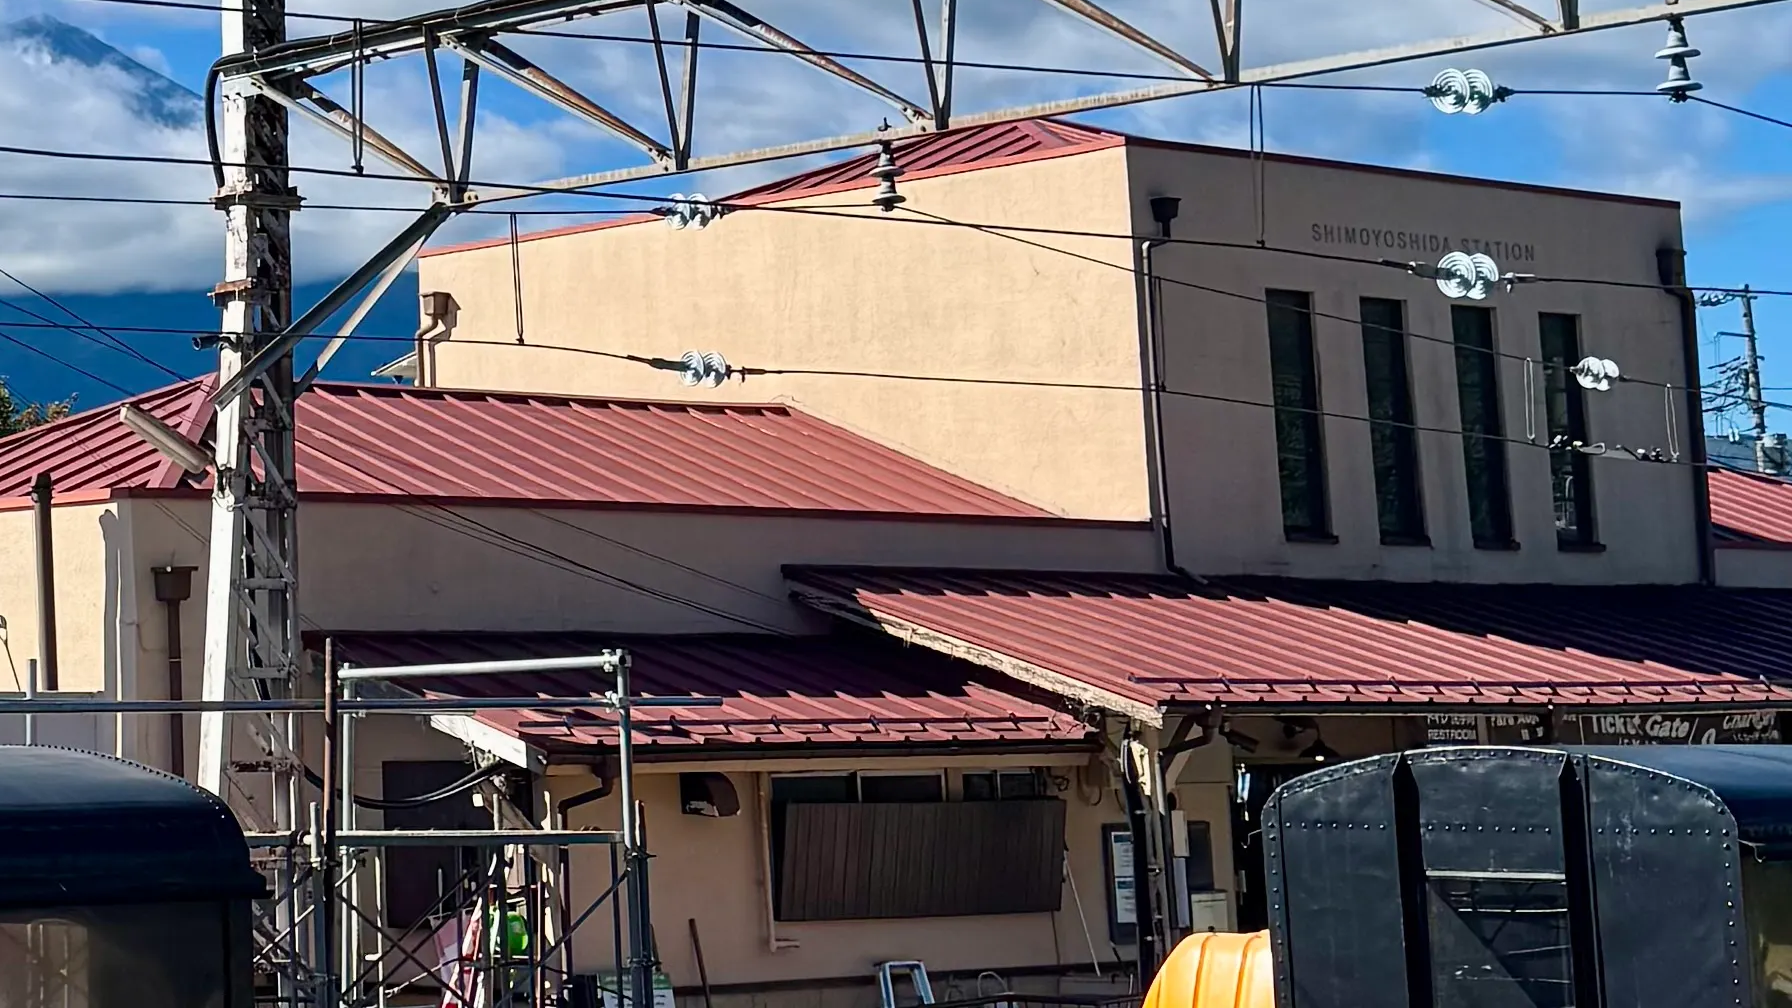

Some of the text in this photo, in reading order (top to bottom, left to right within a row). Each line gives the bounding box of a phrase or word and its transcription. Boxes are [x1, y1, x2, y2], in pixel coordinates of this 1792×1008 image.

[1311, 223, 1535, 261] SHIMOYOSHIDA STATION
[1427, 729, 1477, 740] RESTROOM
[1645, 715, 1690, 738] Gate
